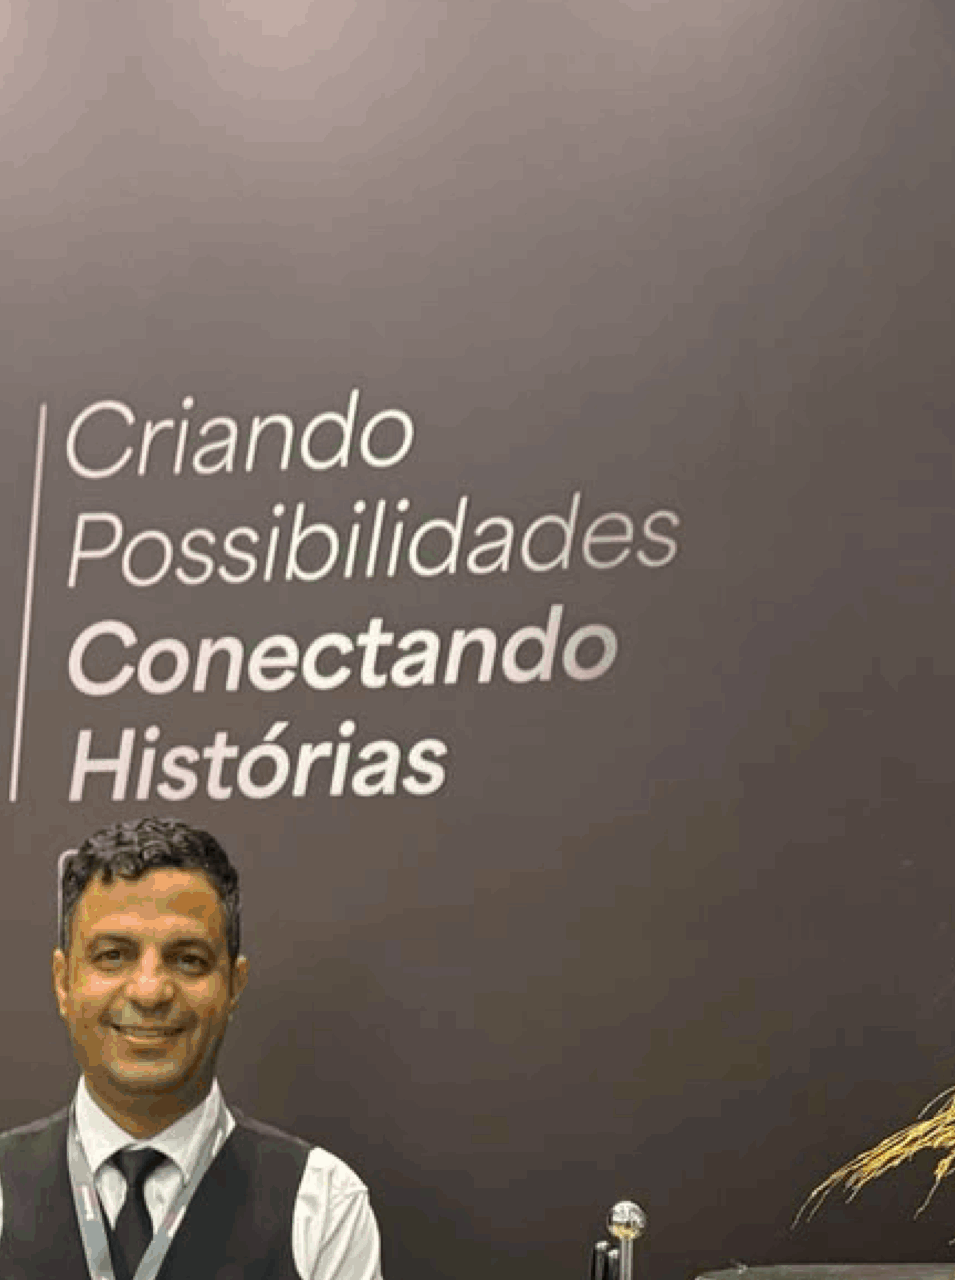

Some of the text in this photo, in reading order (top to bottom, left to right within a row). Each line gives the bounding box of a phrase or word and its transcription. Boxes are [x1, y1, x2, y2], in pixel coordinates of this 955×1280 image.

[66, 388, 415, 479] Criando
[67, 491, 681, 588] Possibilidades
[68, 603, 618, 696] Conectando
[68, 720, 448, 802] Histórias
